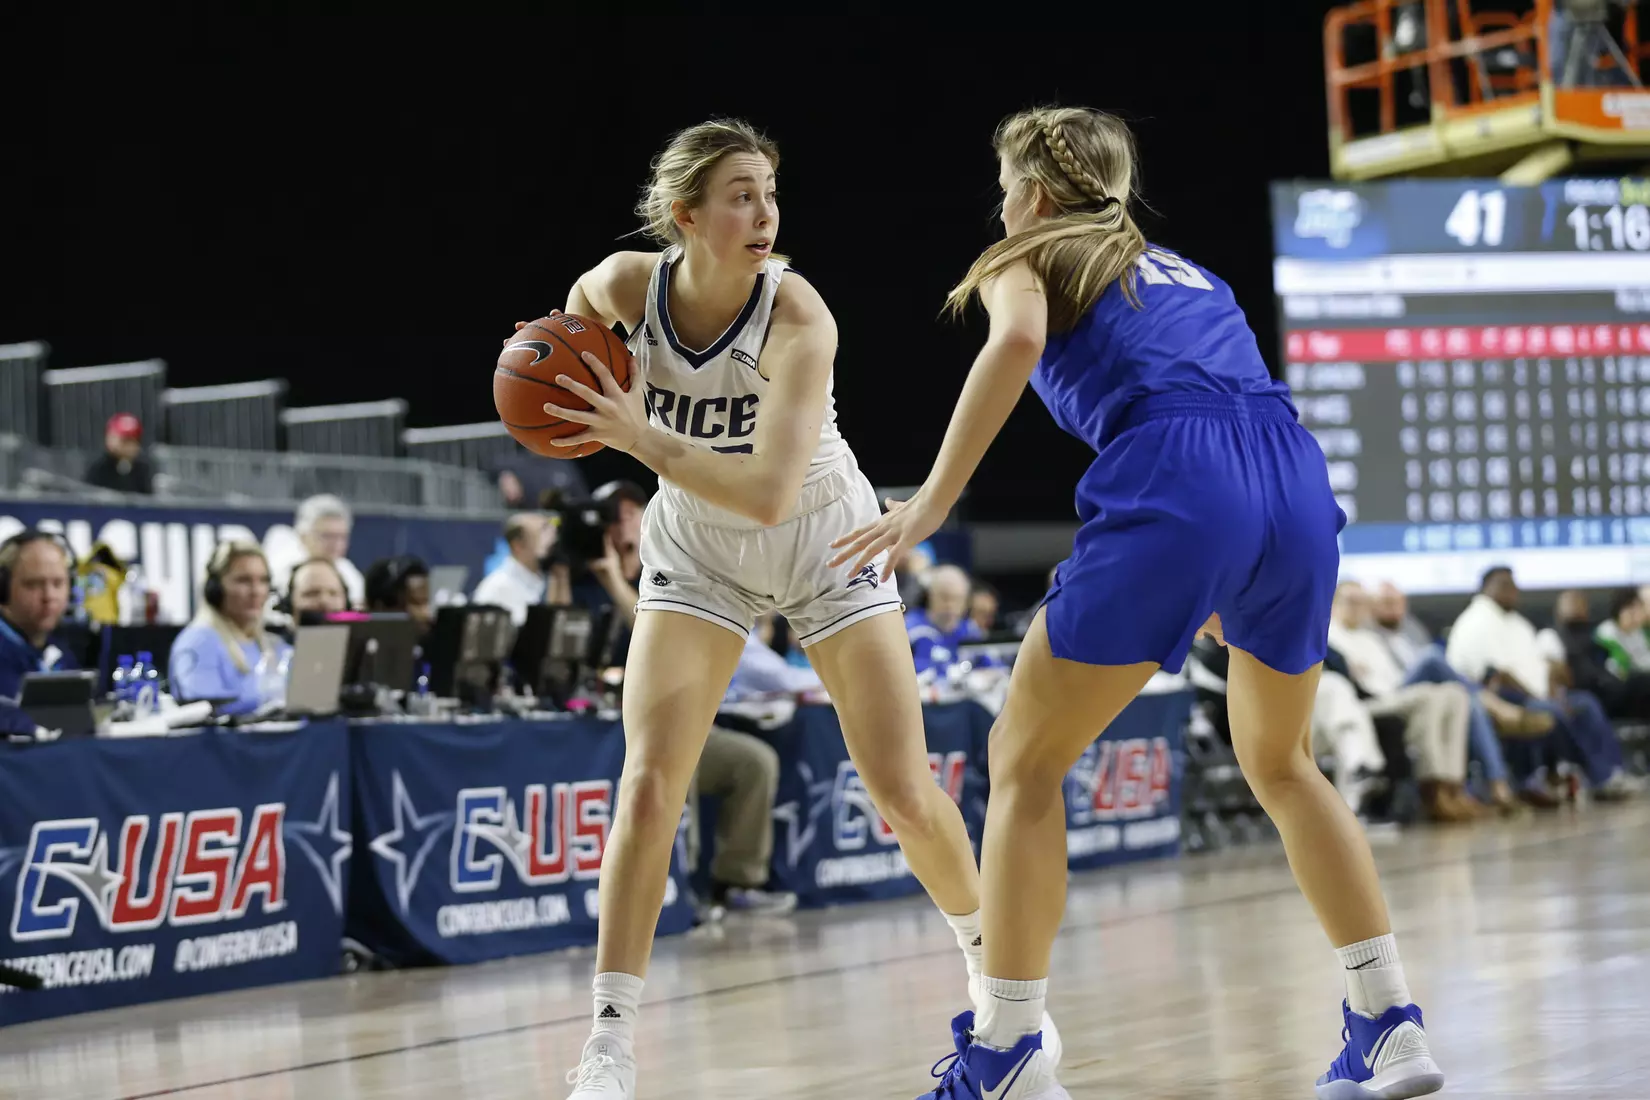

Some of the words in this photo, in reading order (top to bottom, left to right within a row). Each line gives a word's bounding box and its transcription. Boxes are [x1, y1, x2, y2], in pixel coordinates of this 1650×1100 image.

[1444, 190, 1507, 247] 41
[1566, 204, 1650, 251] 1:16
[642, 381, 760, 438] RICE
[450, 778, 619, 893] CUS
